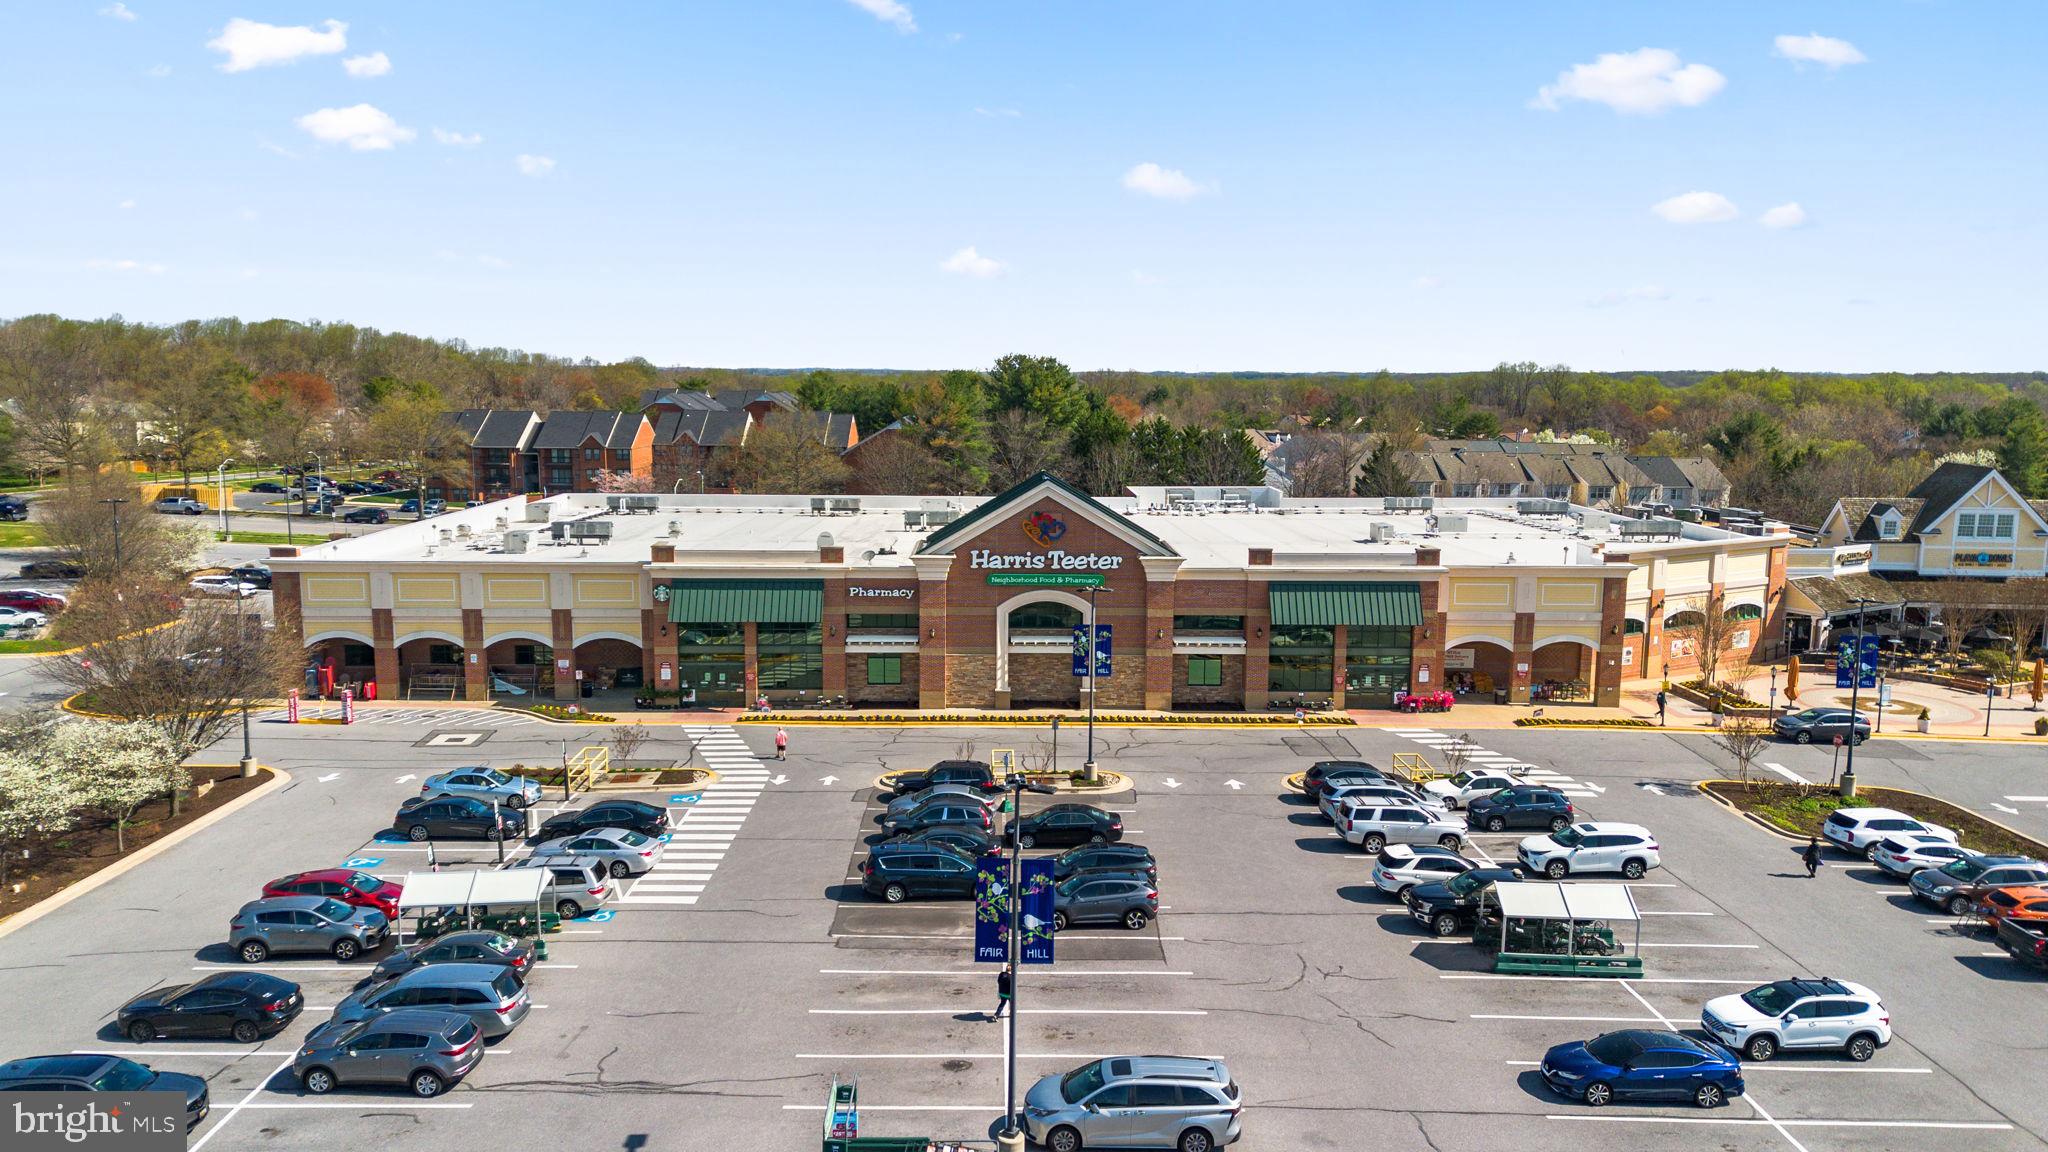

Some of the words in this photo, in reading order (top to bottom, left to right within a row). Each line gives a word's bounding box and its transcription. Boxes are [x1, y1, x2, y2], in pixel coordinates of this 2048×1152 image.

[970, 549, 1045, 569] Harris
[1048, 550, 1123, 569] Teeter
[991, 576, 1038, 584] Neighborhood
[1039, 576, 1056, 584] Food
[1065, 577, 1100, 585] Pharmacy
[849, 586, 914, 599] Pharmacy
[979, 947, 1003, 957] FAIR
[1026, 949, 1049, 959] HILL
